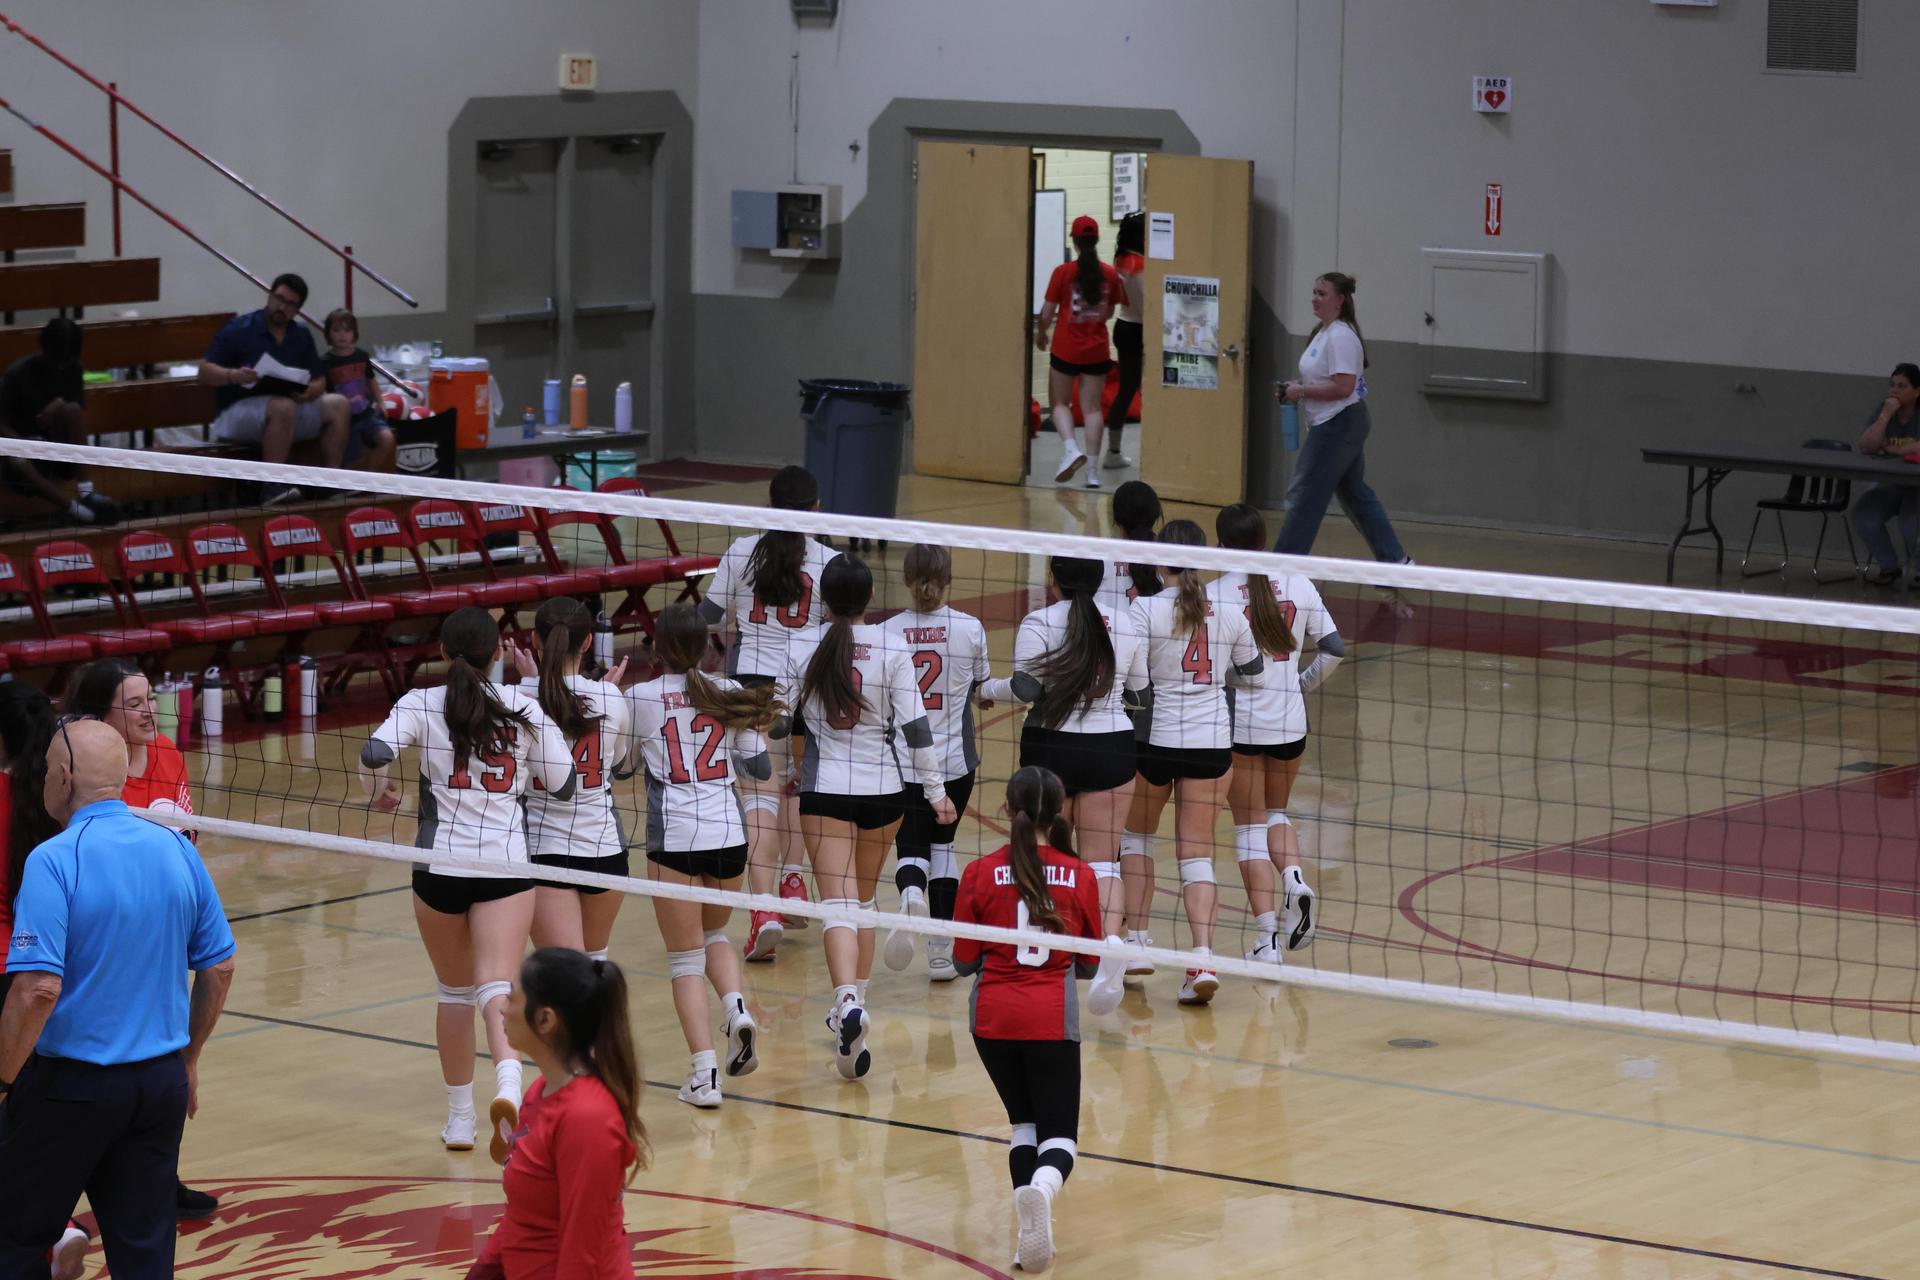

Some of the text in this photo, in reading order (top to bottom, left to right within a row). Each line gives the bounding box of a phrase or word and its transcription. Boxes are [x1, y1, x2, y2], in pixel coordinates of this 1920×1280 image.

[1485, 78, 1507, 88] AED
[1165, 281, 1217, 297] CHOWCHILLA
[1176, 352, 1199, 365] TRIBE
[903, 626, 947, 644] TRIBE
[1181, 623, 1212, 685] 4
[912, 649, 943, 710] 2
[660, 691, 692, 711] TRI
[532, 719, 605, 791] 4
[660, 713, 728, 784] 12
[994, 865, 1076, 888] CHILLA
